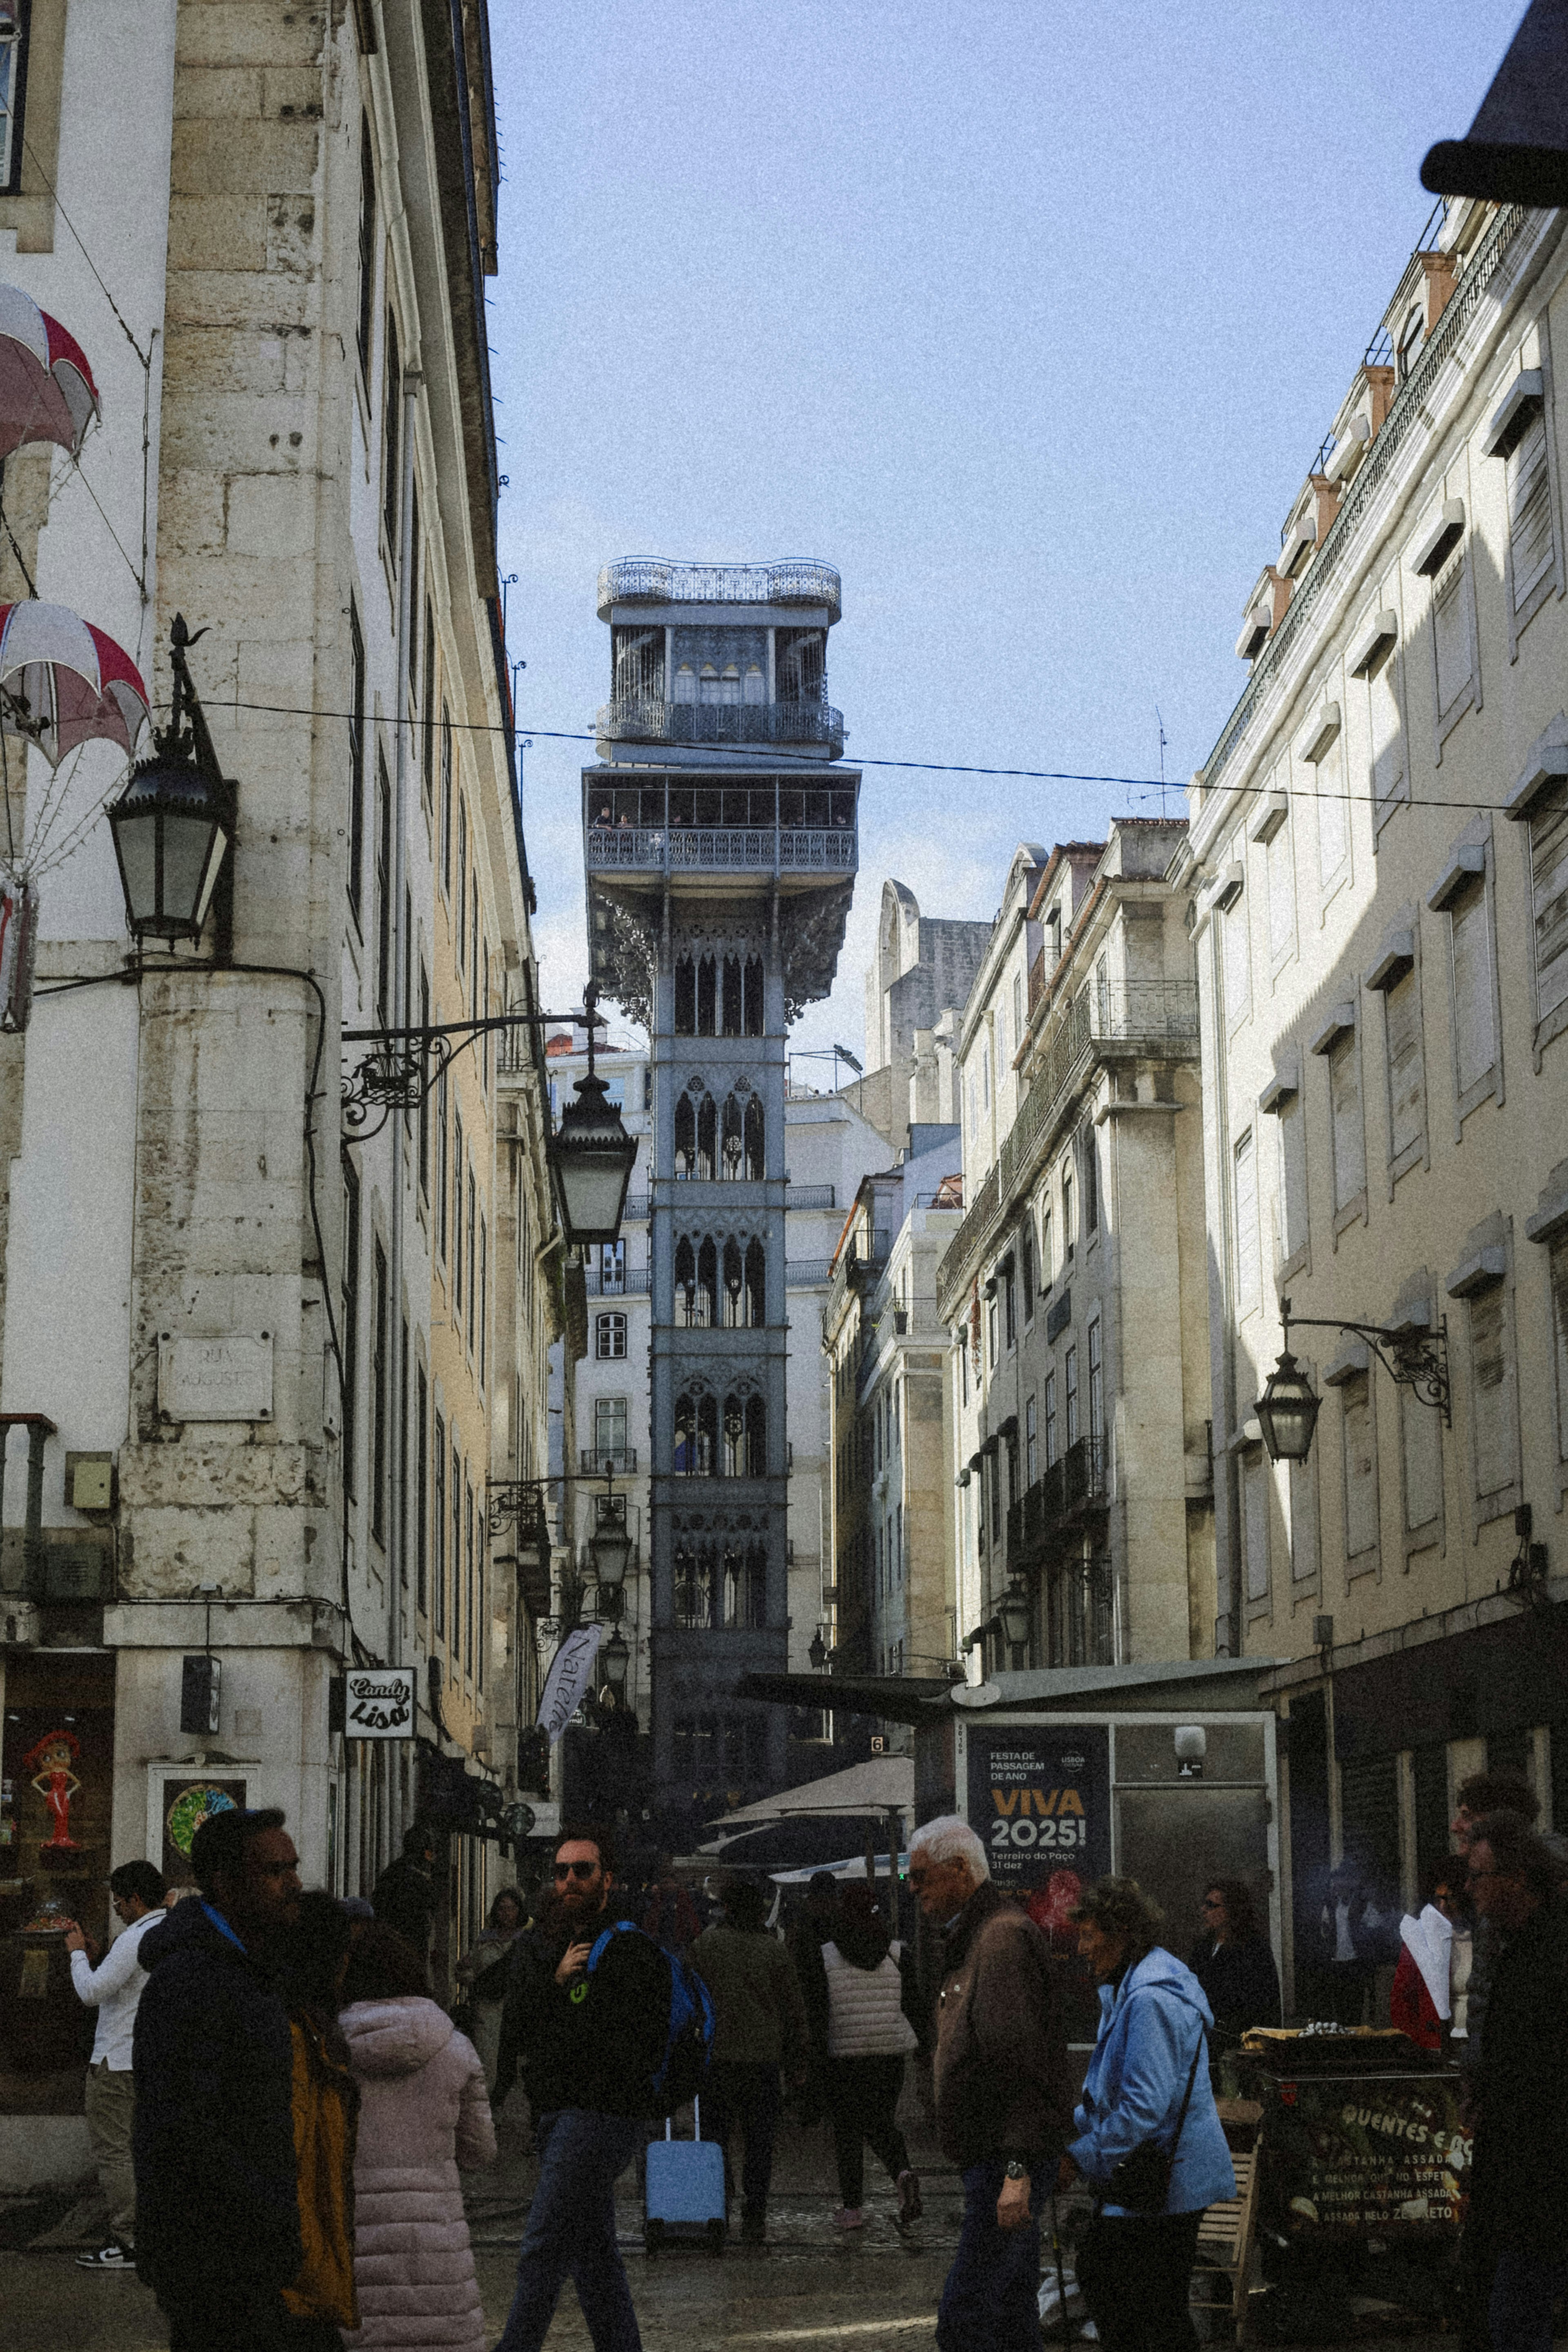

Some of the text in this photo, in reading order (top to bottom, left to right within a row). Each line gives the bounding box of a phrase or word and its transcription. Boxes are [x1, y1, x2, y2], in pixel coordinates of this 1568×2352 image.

[350, 1677, 410, 1705] Candy
[349, 1701, 410, 1729] Lisa
[873, 1738, 882, 1751] 6
[990, 1752, 1035, 1760] FESTA DE
[990, 1762, 1045, 1771] PASSAGEM
[991, 1772, 1027, 1780] DE ANO
[991, 1789, 1085, 1816] VIVA
[991, 1819, 1086, 1847] 2025!
[992, 1852, 1075, 1862] Terreiro do Paço
[1342, 2104, 1429, 2143] QUENTES
[1434, 2130, 1446, 2148] E
[1416, 2171, 1446, 2182] ESPET
[1312, 2193, 1319, 2202] A
[1321, 2191, 1361, 2201] MELHOR
[1363, 2189, 1413, 2200] CASTANHA
[1324, 2211, 1361, 2222] ASSADA
